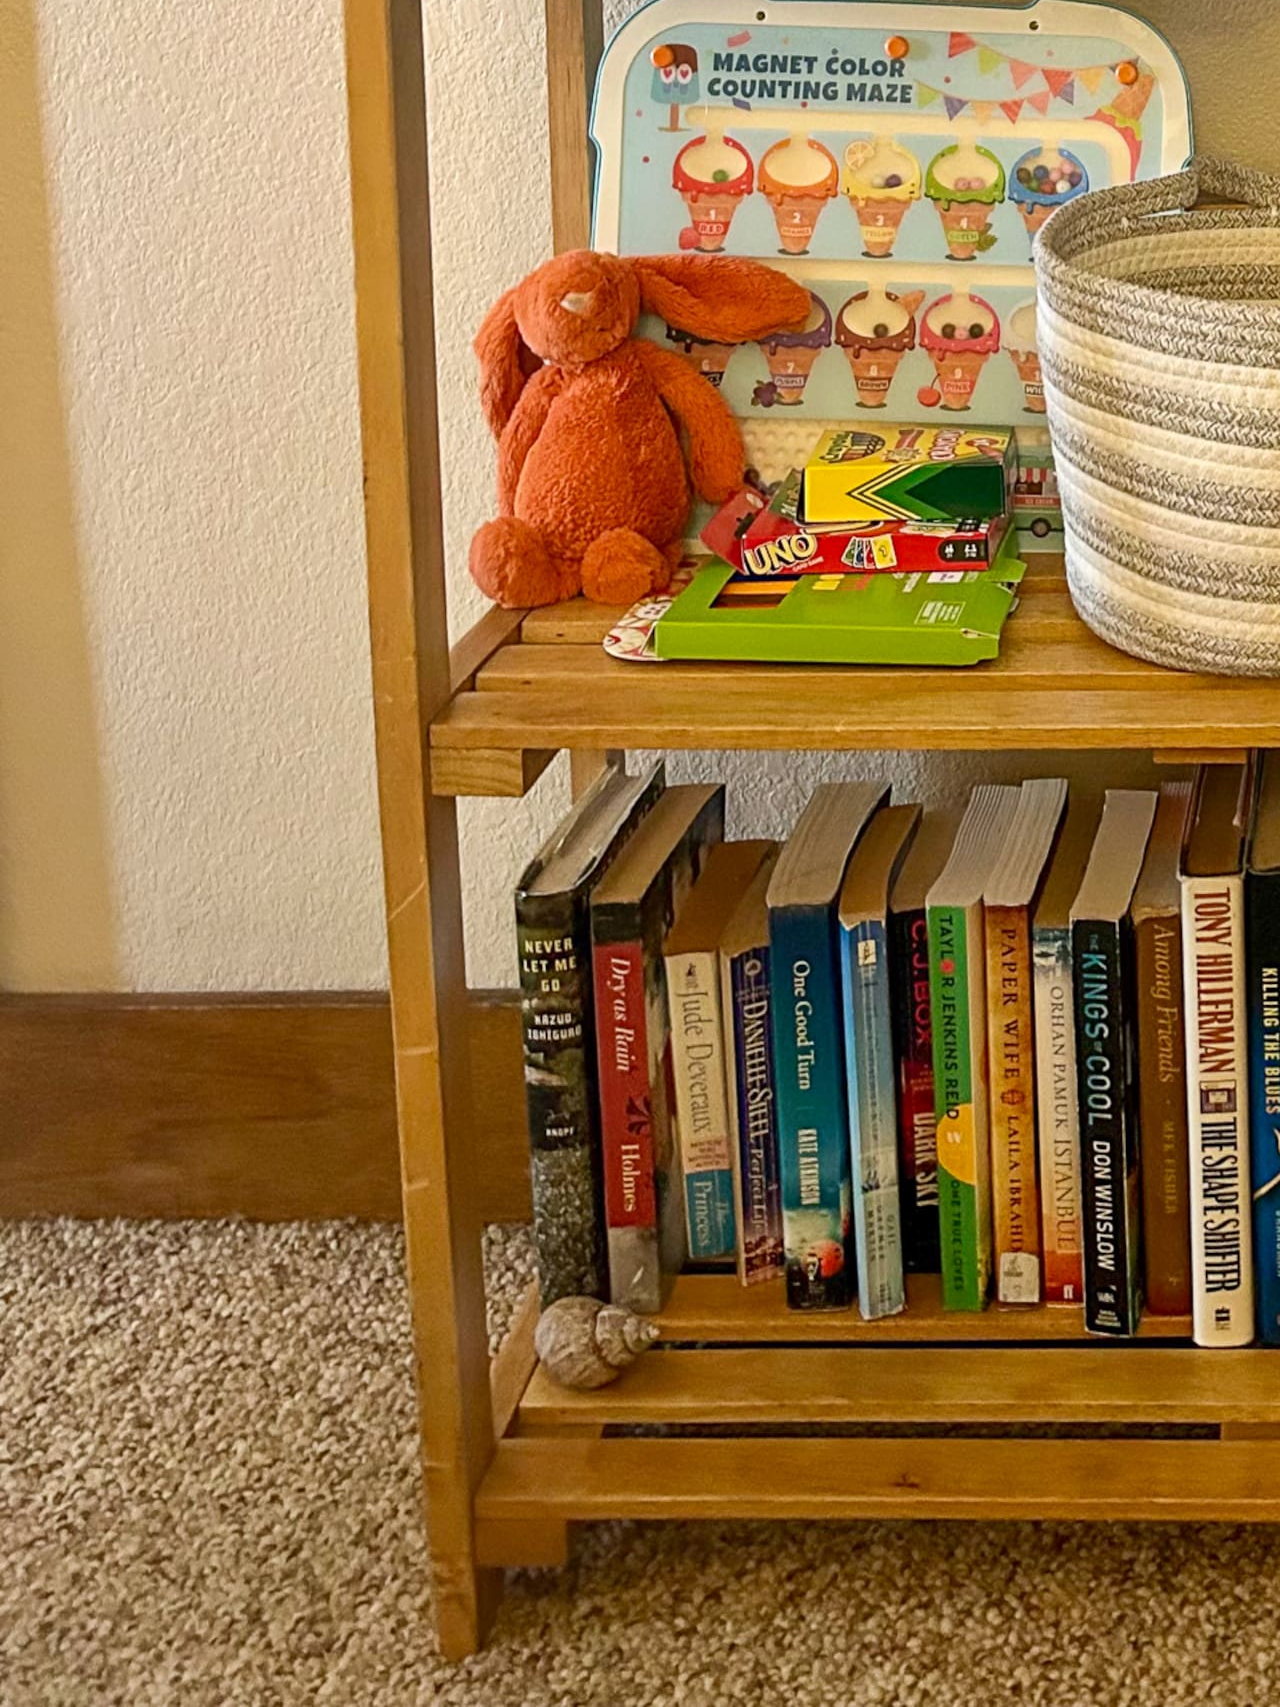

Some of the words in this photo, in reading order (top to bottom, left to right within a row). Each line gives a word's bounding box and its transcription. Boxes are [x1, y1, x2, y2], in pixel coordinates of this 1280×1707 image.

[712, 52, 818, 74] MAGNET
[825, 56, 906, 78] COLOR
[707, 78, 838, 101] COUNTING
[846, 83, 913, 104] MAZE
[700, 223, 724, 234] RED
[708, 209, 716, 221] 1
[792, 212, 801, 224] 2
[876, 215, 884, 226] 3
[960, 216, 967, 229] 4
[743, 533, 818, 576] UNO
[1193, 887, 1233, 947] TONY
[523, 960, 548, 973] LET
[554, 957, 577, 972] ME
[525, 937, 573, 954] NEVER
[1001, 929, 1019, 1006] PAPER
[1150, 924, 1176, 1003] Among
[541, 979, 560, 992] GO
[607, 957, 631, 996] Dry
[792, 960, 811, 998] One
[1081, 951, 1110, 1039] KINGS
[1261, 967, 1280, 1028] KILLING
[534, 1013, 572, 1026] KAZUO
[612, 999, 628, 1021] as
[677, 991, 709, 1036] Jude
[794, 1000, 815, 1047] Good
[941, 991, 958, 1072] JENKINS
[1050, 986, 1065, 1057] ORHAN
[1195, 953, 1236, 1075] HILLERMAN
[527, 1025, 582, 1041] ISHIGURO
[615, 1026, 637, 1072] Rain
[743, 999, 769, 1088] DANIELLE
[1003, 1018, 1021, 1080] WIFE
[1156, 1005, 1182, 1084] Friends
[1263, 1032, 1280, 1061] THE
[684, 1042, 714, 1134] Deveraux
[797, 1050, 816, 1091] Turn
[1085, 1055, 1113, 1127] COOL
[1263, 1066, 1280, 1115] BLUES
[747, 1088, 774, 1144] STEEL
[944, 1075, 960, 1120] REID
[1052, 1065, 1069, 1129] PAMUK
[546, 1126, 575, 1137] KNOPF
[798, 1128, 818, 1156] KATE
[1007, 1115, 1020, 1172] LAILA
[1200, 1116, 1238, 1153] THE
[621, 1143, 643, 1213] Holmes
[799, 1158, 821, 1206] ATKINSON
[1092, 1140, 1112, 1181] DON
[915, 1170, 939, 1208] SKY
[951, 1180, 962, 1207] ONE
[1053, 1139, 1077, 1254] ISTANBUL
[1201, 1154, 1240, 1216] SHAPE
[693, 1180, 713, 1246] Princess
[952, 1212, 963, 1248] TRUE
[1095, 1184, 1116, 1272] WINSLOW
[1203, 1218, 1242, 1294] SHIFTER
